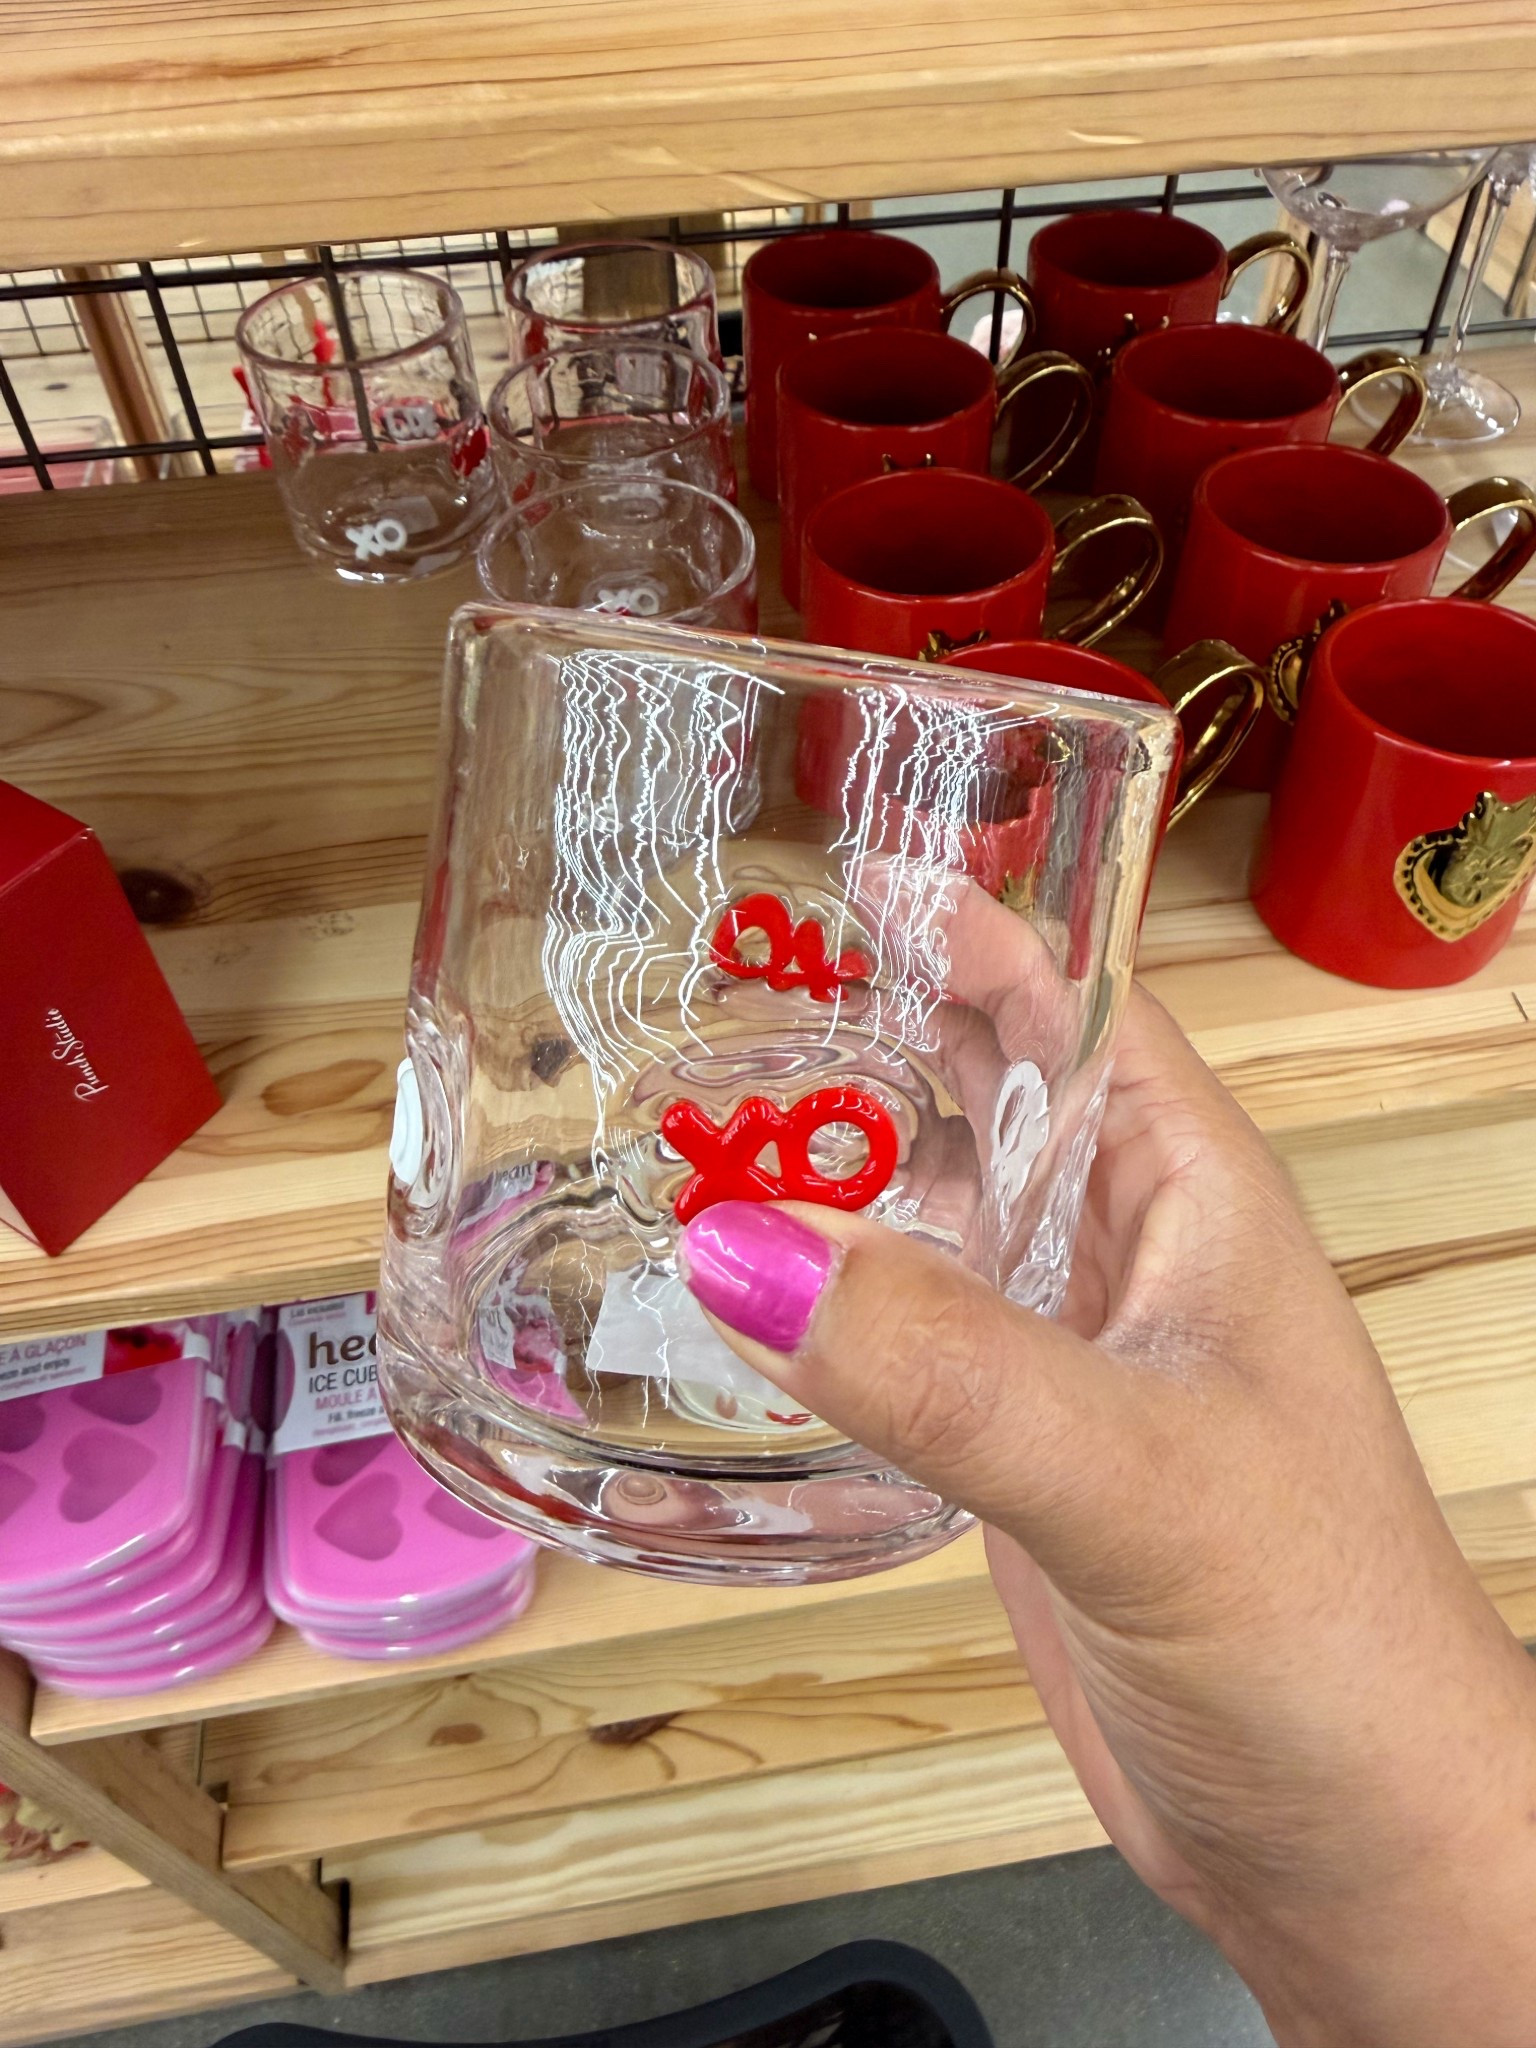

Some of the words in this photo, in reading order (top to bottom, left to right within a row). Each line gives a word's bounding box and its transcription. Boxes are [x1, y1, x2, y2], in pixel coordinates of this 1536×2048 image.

[345, 518, 408, 561] XO
[45, 1008, 84, 1060] Studio
[66, 1052, 109, 1101] Punch
[660, 1086, 898, 1226] XO
[309, 1372, 338, 1394] ICE
[343, 1364, 377, 1387] CUB
